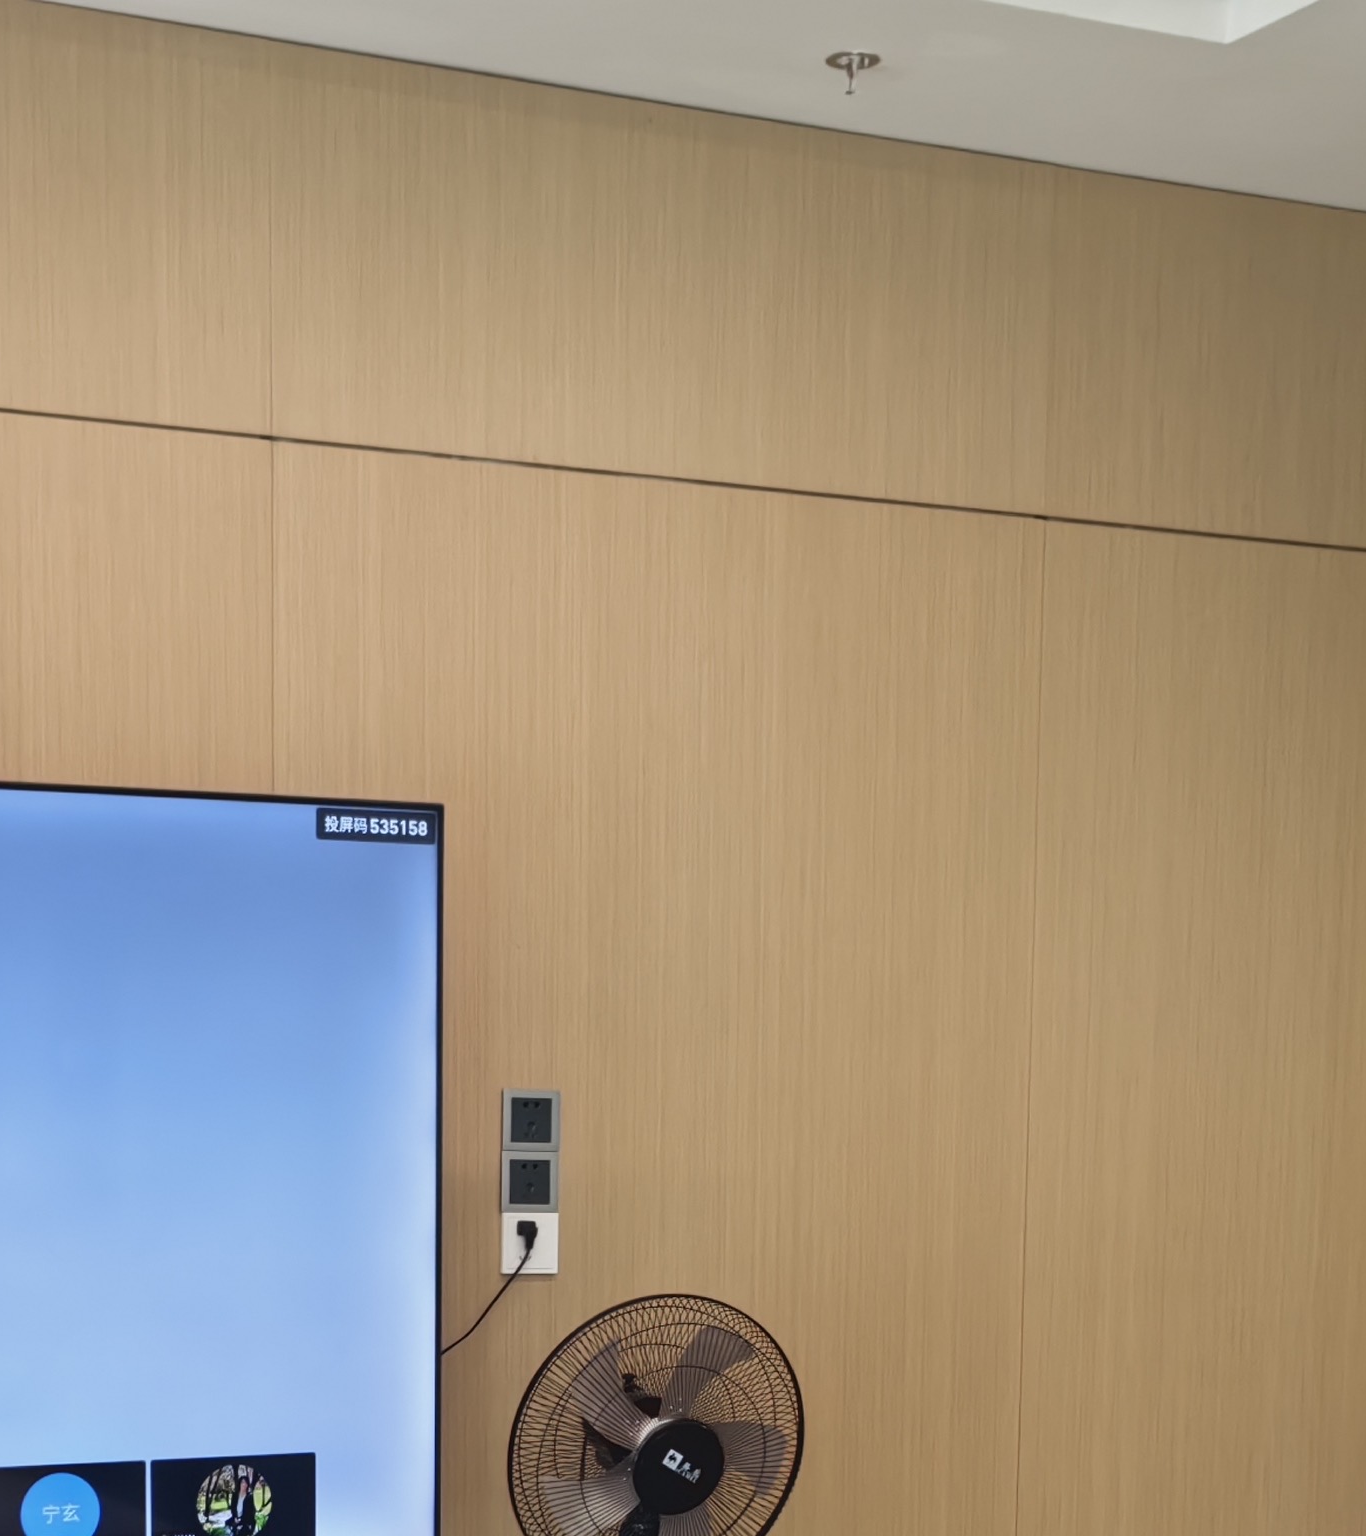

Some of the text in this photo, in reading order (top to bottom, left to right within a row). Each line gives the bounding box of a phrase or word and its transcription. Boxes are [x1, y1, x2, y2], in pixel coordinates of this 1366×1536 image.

[324, 815, 428, 837] 投屏码 535158
[42, 1504, 80, 1524] 宁玄
